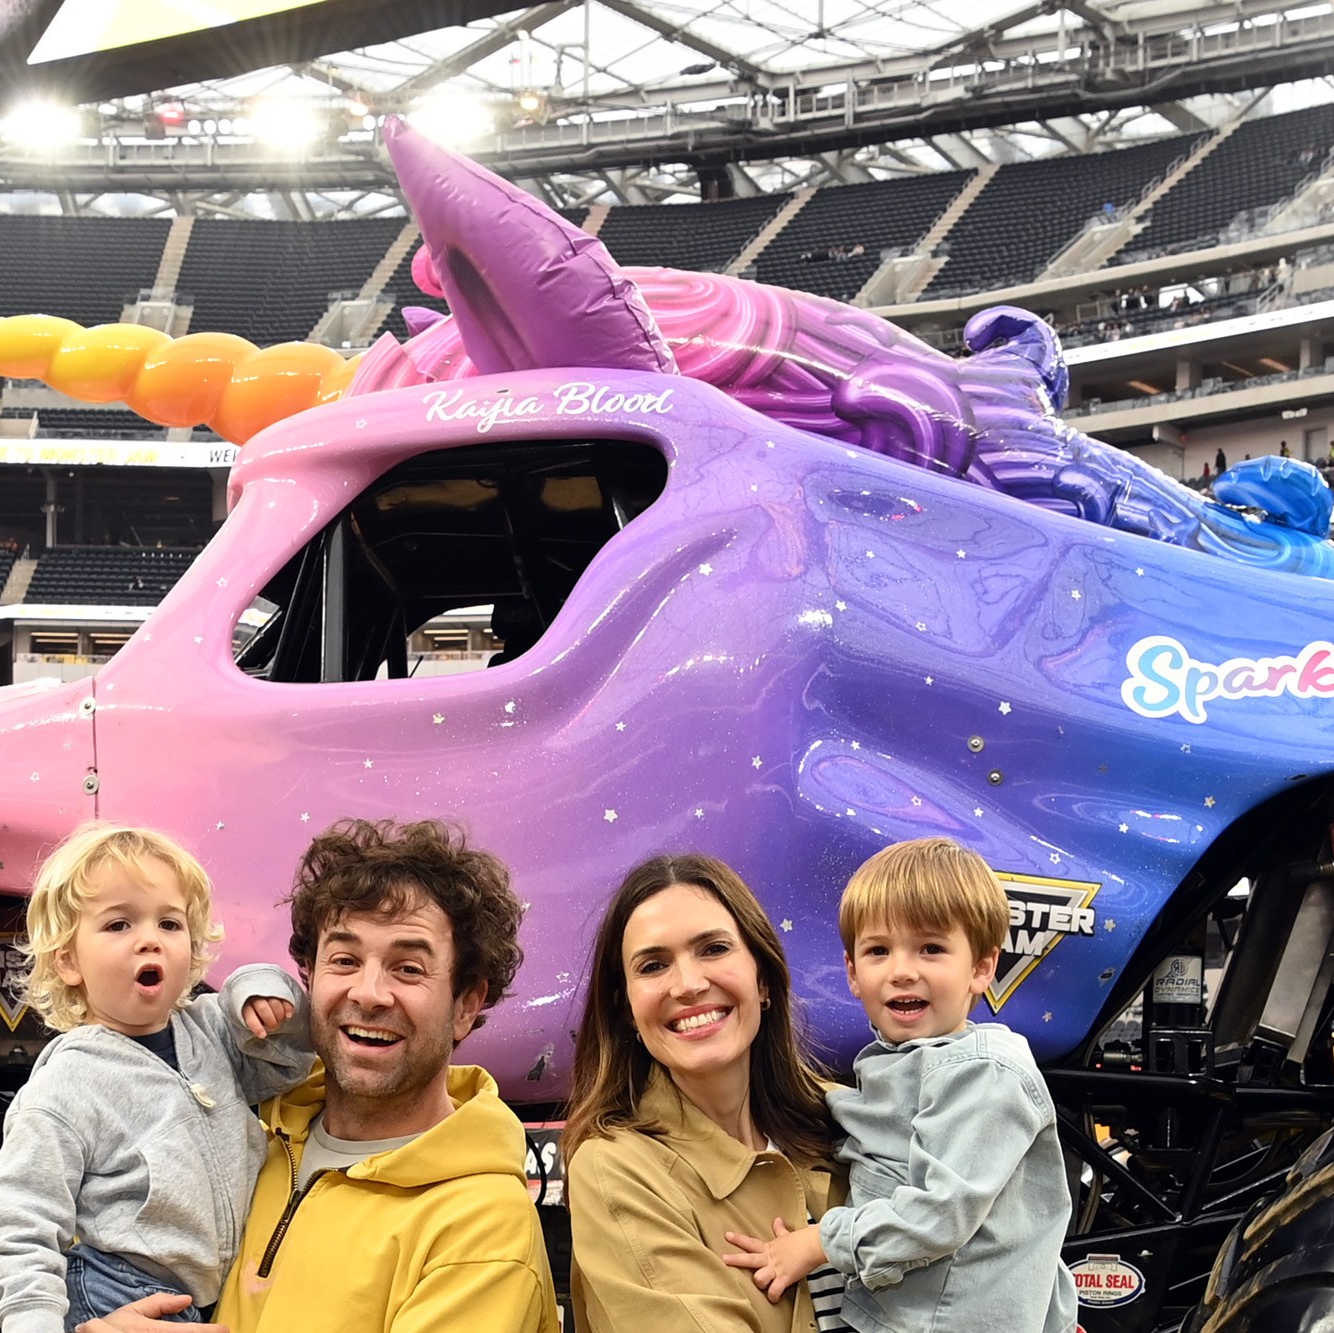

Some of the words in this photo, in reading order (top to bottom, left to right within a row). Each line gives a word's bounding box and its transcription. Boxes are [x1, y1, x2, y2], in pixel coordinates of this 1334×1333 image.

[554, 382, 675, 415] Blood
[1009, 901, 1095, 934] STER
[1001, 929, 1048, 956] AM
[1155, 978, 1200, 986] RADIAL
[1106, 1274, 1134, 1288] SEAL
